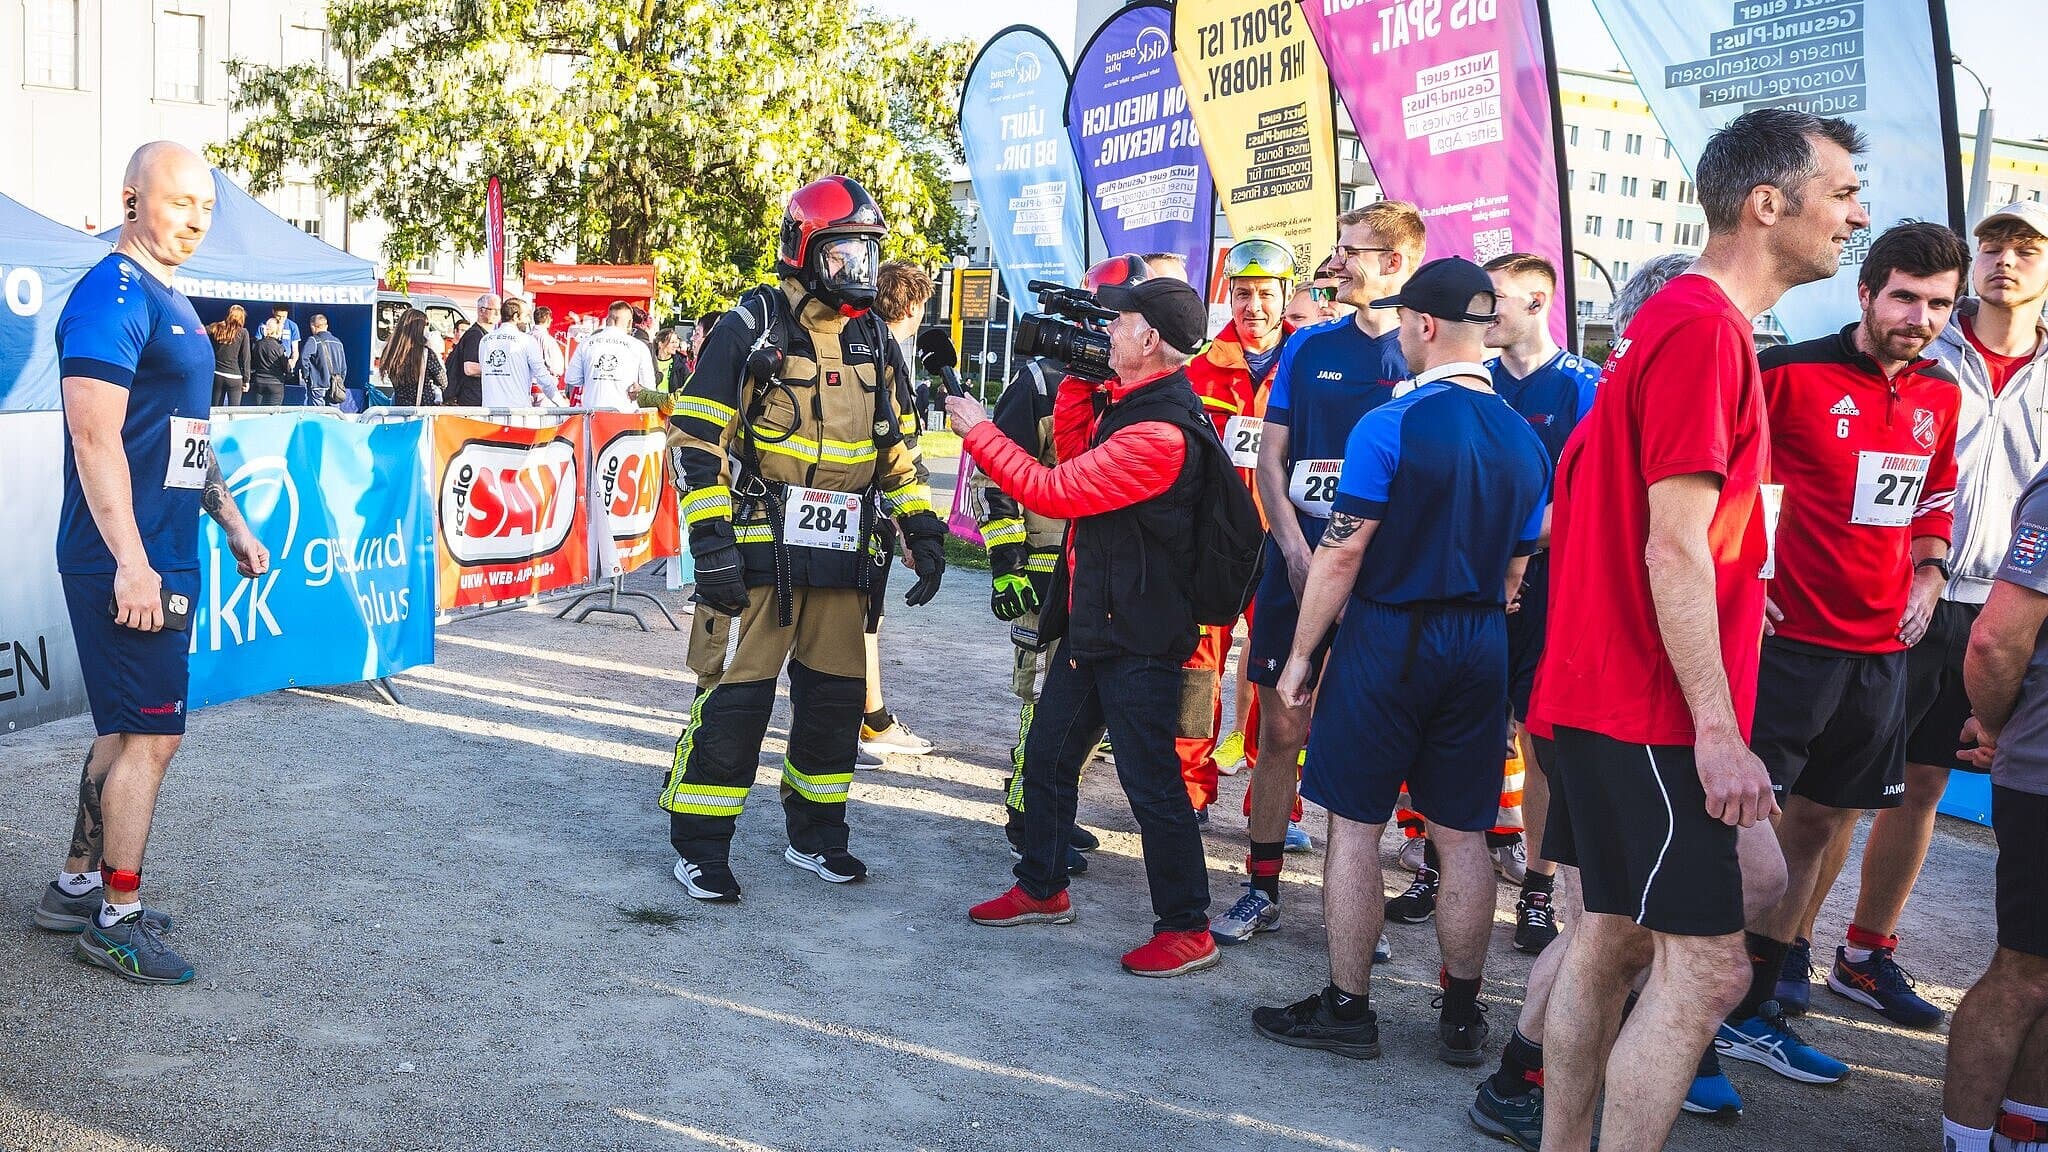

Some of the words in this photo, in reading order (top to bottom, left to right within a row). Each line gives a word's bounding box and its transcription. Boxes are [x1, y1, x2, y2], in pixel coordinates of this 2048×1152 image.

[1317, 370, 1342, 381] JAKO
[1829, 406, 1860, 416] adidas
[1836, 418, 1850, 439] 6
[1234, 430, 1262, 453] 28
[1309, 461, 1342, 473] FIRMENL
[456, 463, 473, 537] radio
[464, 461, 570, 539] SAW
[803, 490, 848, 505] FIRMENLAUF
[1303, 476, 1340, 502] 28
[1874, 473, 1924, 506] 271
[799, 504, 848, 533] 284
[304, 518, 407, 587] gesund
[190, 547, 283, 654] kk
[1883, 782, 1905, 795] JAKO
